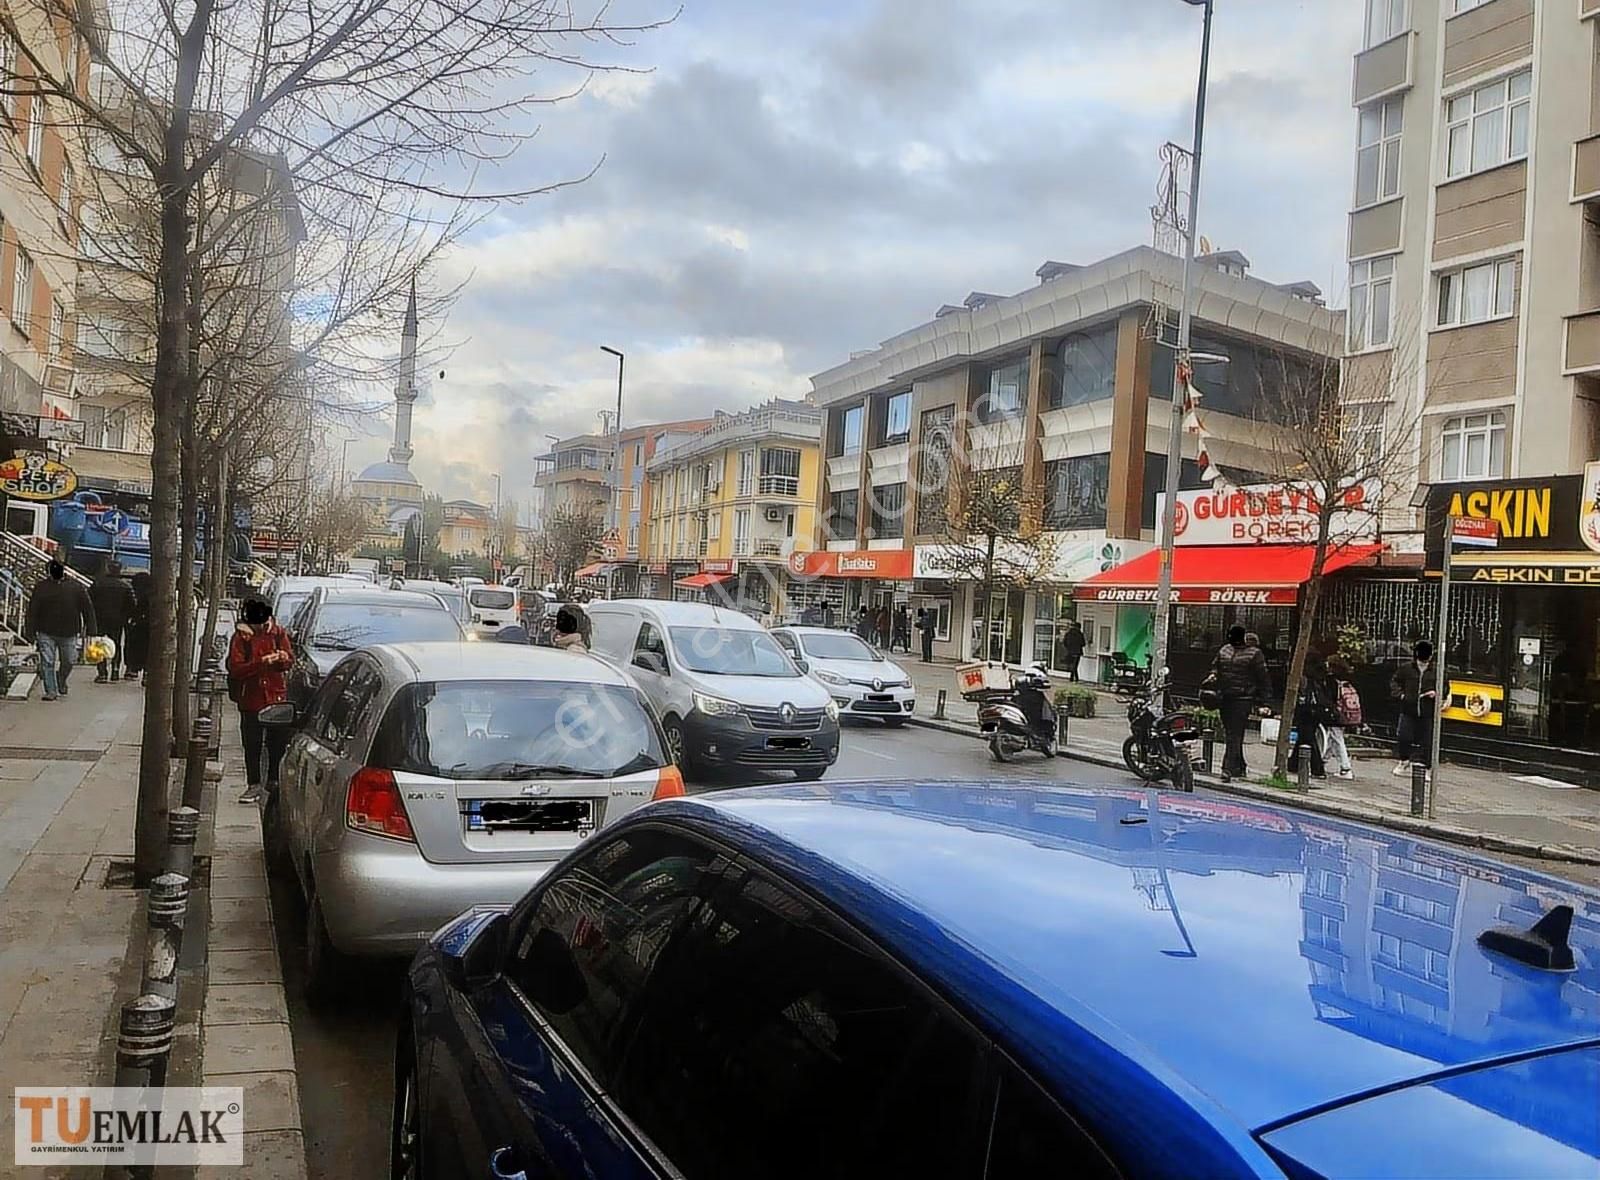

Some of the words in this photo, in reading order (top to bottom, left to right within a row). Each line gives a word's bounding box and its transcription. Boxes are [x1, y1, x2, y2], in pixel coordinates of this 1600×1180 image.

[5, 479, 65, 494] SHOP
[1193, 485, 1364, 520] GÜREYLR
[1232, 518, 1313, 539] BÖREK
[1098, 587, 1181, 602] GÜRBEYLR
[1209, 587, 1271, 603] BÖREK
